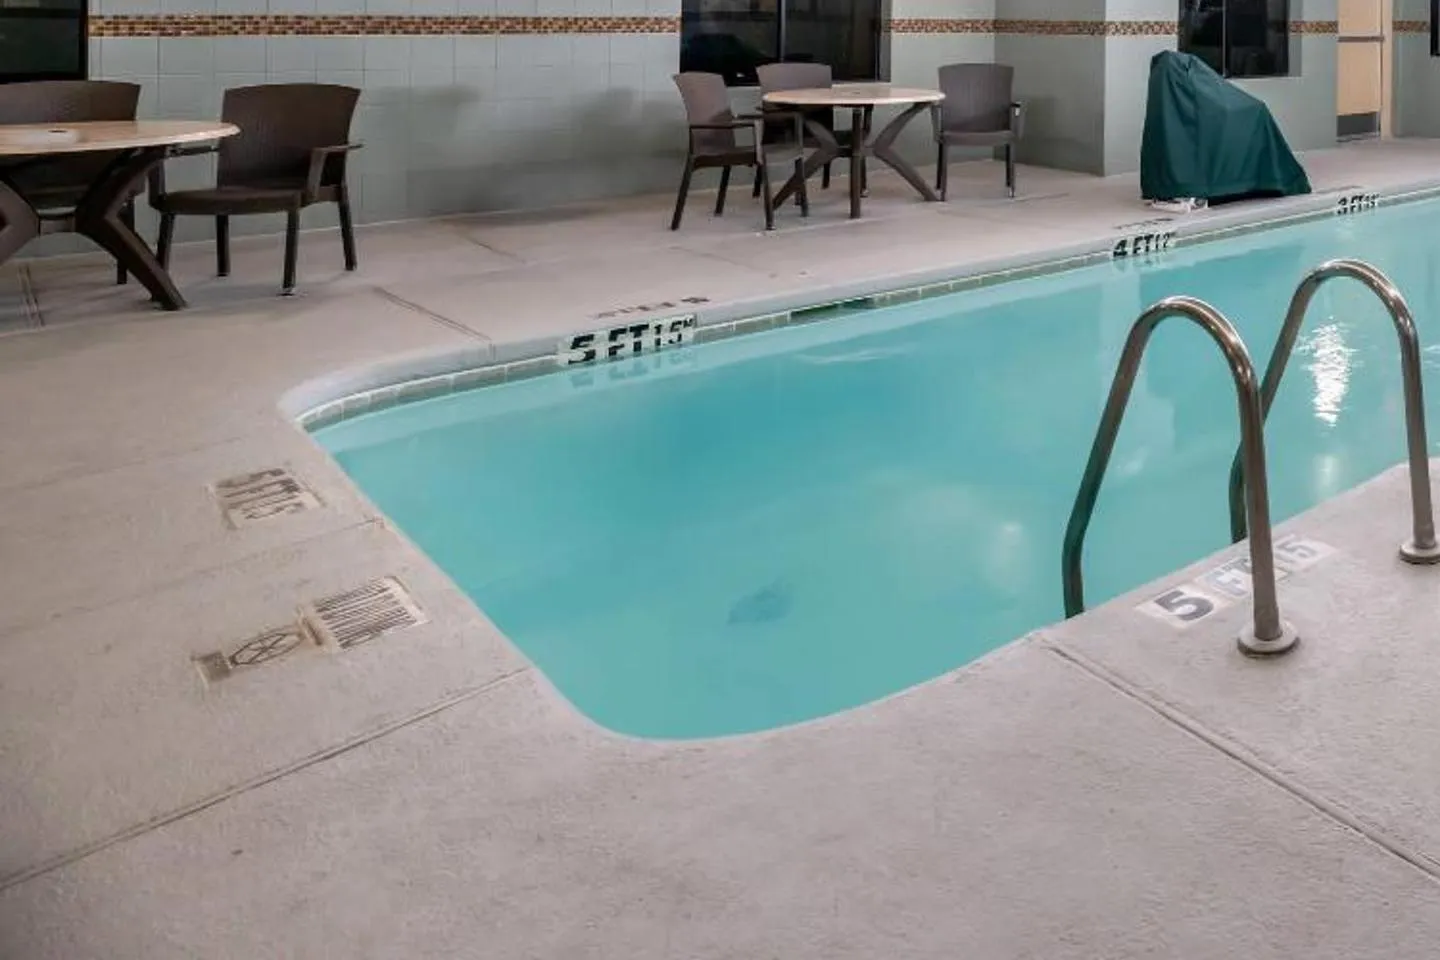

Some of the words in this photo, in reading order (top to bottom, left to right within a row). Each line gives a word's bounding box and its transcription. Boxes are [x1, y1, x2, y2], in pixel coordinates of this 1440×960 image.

[1113, 239, 1127, 258] 4
[1133, 234, 1154, 255] FT
[568, 333, 596, 365] 5
[608, 323, 649, 357] FT
[1154, 589, 1215, 621] 5
